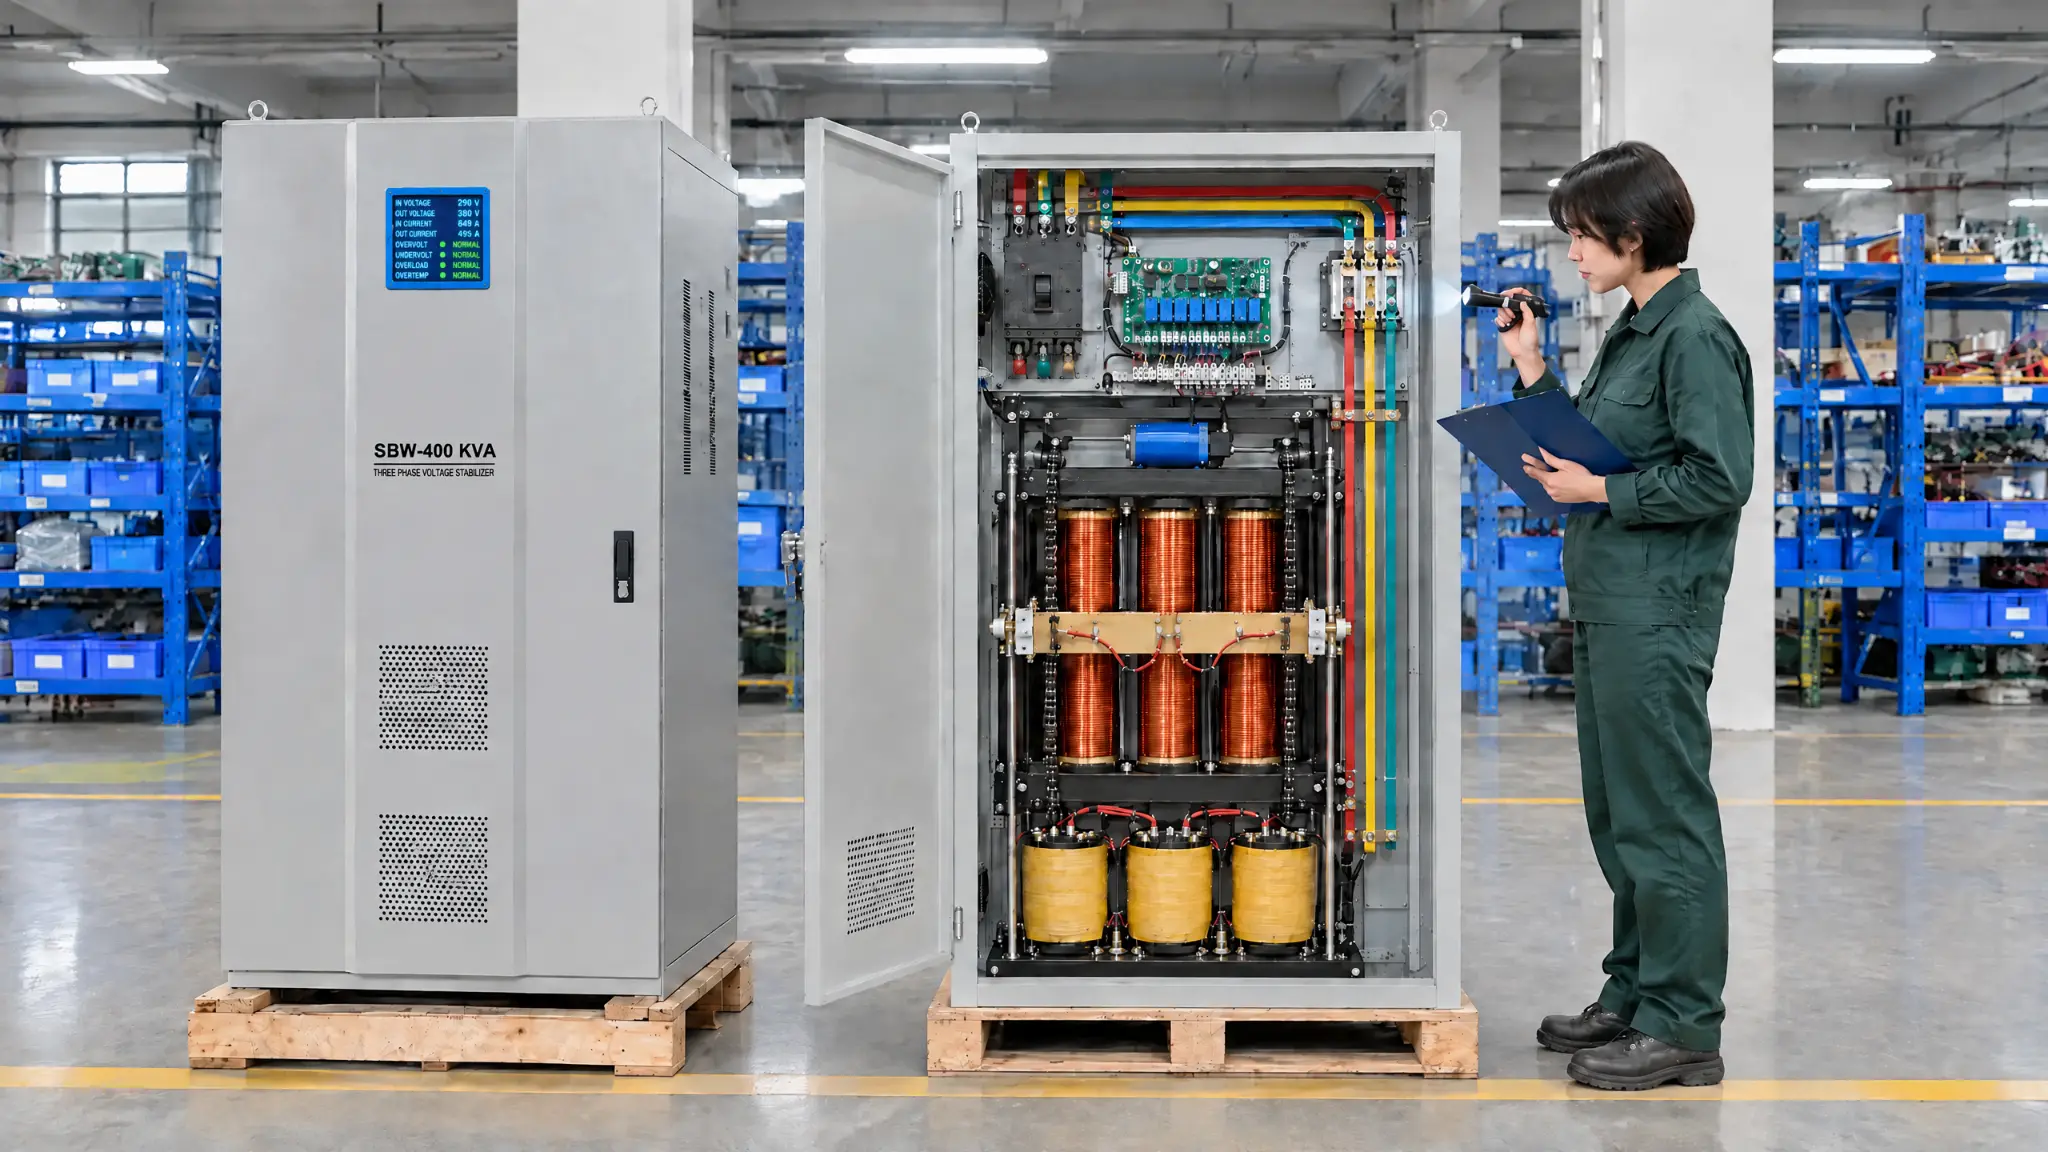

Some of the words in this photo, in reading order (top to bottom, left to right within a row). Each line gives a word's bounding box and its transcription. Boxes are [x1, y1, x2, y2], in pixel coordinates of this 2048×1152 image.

[395, 199, 402, 207] IN
[403, 199, 431, 207] VOLTAGE
[458, 199, 472, 207] 290
[474, 199, 480, 207] V
[395, 209, 408, 217] OUT
[409, 209, 435, 217] VOLTAGE
[458, 209, 472, 217] 380
[474, 209, 480, 217] V
[395, 219, 402, 227] IN
[403, 219, 432, 227] CURRENT
[474, 219, 480, 227] A
[452, 251, 480, 259] NORMAL
[395, 261, 429, 269] OVERLOAD
[452, 261, 480, 269] NORMAL
[374, 443, 453, 458] SBW-400
[459, 443, 496, 458] KVA
[373, 468, 396, 477] THREE
[397, 468, 421, 477] PHASE
[422, 468, 454, 477] VOLTAGE
[455, 468, 495, 477] STABILIZER
